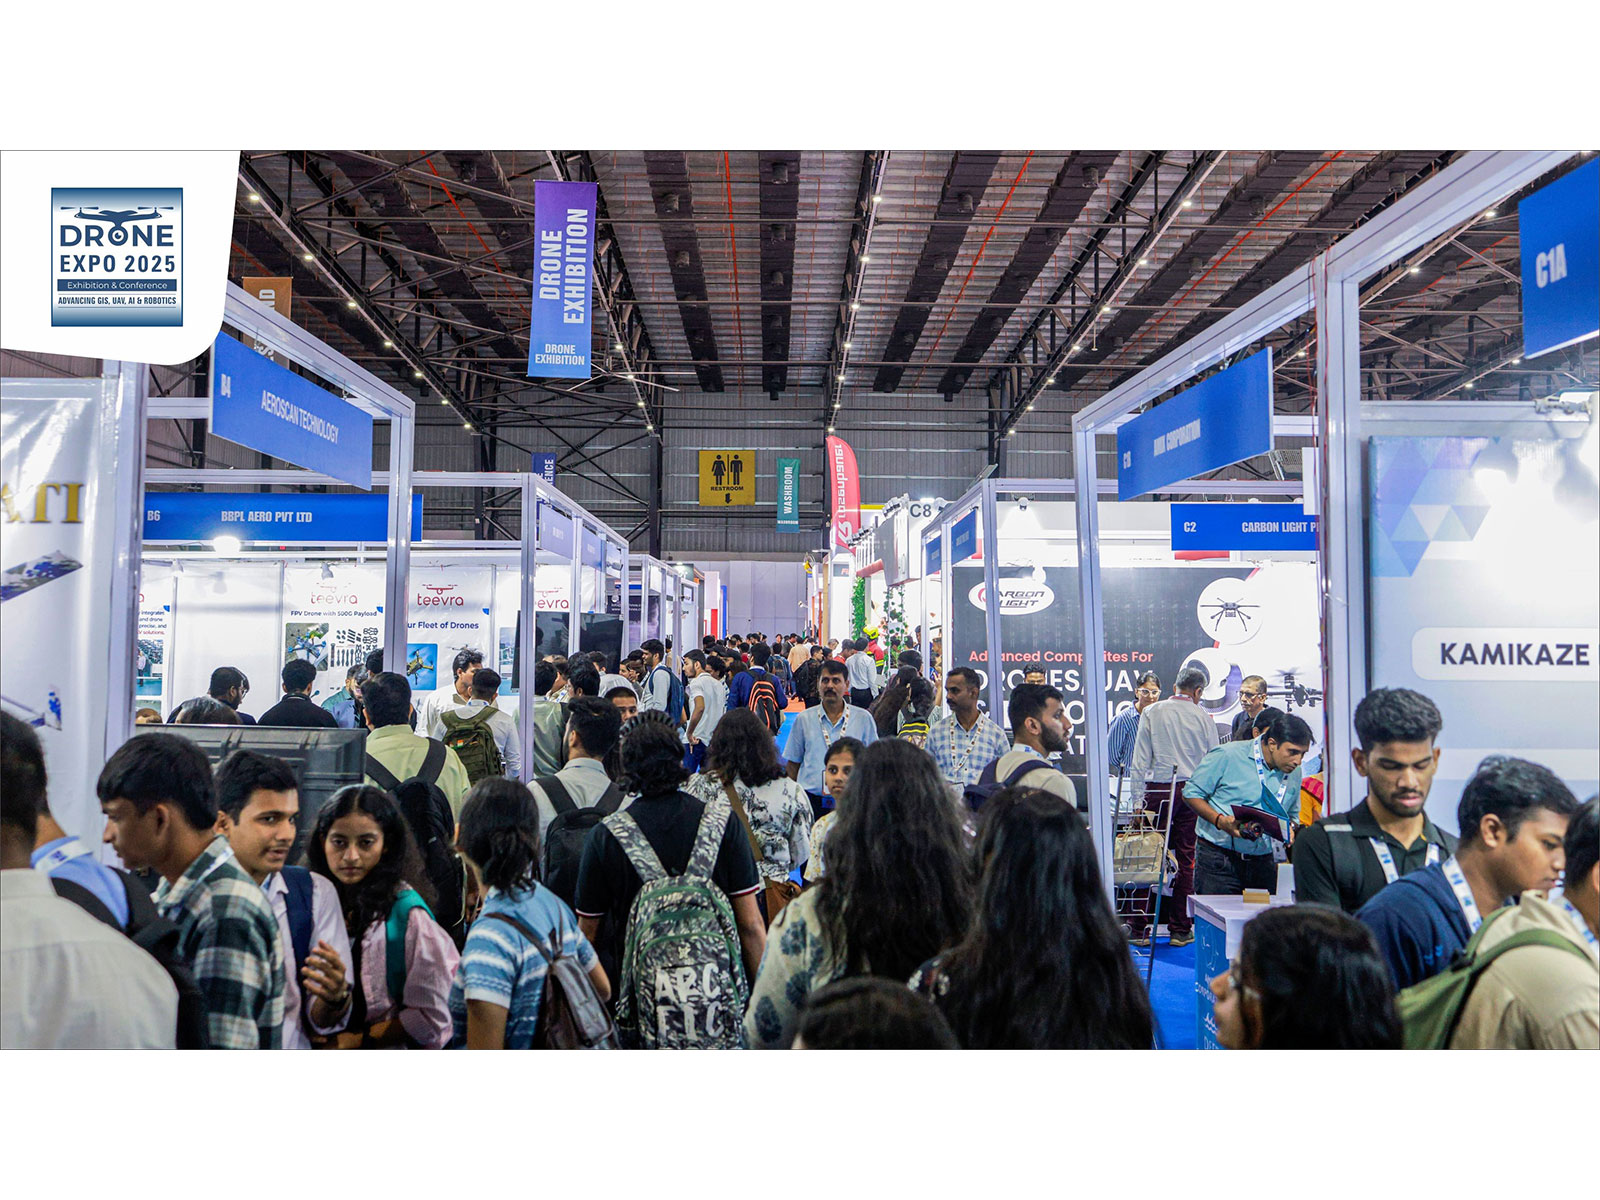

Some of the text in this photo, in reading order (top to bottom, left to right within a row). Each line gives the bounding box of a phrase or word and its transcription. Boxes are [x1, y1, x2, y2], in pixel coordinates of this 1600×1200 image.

[539, 230, 562, 301] DRONE
[563, 209, 588, 324] EXHIBITION
[1536, 243, 1568, 289] C1A
[545, 343, 576, 355] DRONE
[535, 353, 585, 365] EXHIBITION
[261, 390, 339, 443] AEROSCAN TECHNOLOGY
[783, 467, 793, 514] WASHROOM
[147, 510, 161, 522] B6
[221, 511, 313, 523] BBPL AERO PVT LTD
[910, 504, 932, 518] C8
[1183, 522, 1197, 533] C2
[1241, 522, 1279, 533] CARBON
[1282, 522, 1308, 533] LIGHT
[311, 592, 358, 605] teevra
[417, 593, 464, 606] teevra
[418, 621, 438, 629] Fleet
[440, 621, 449, 629] of
[969, 650, 1041, 662] Adanced
[1132, 651, 1154, 662] For
[1441, 642, 1590, 666] KAMIKAZE
